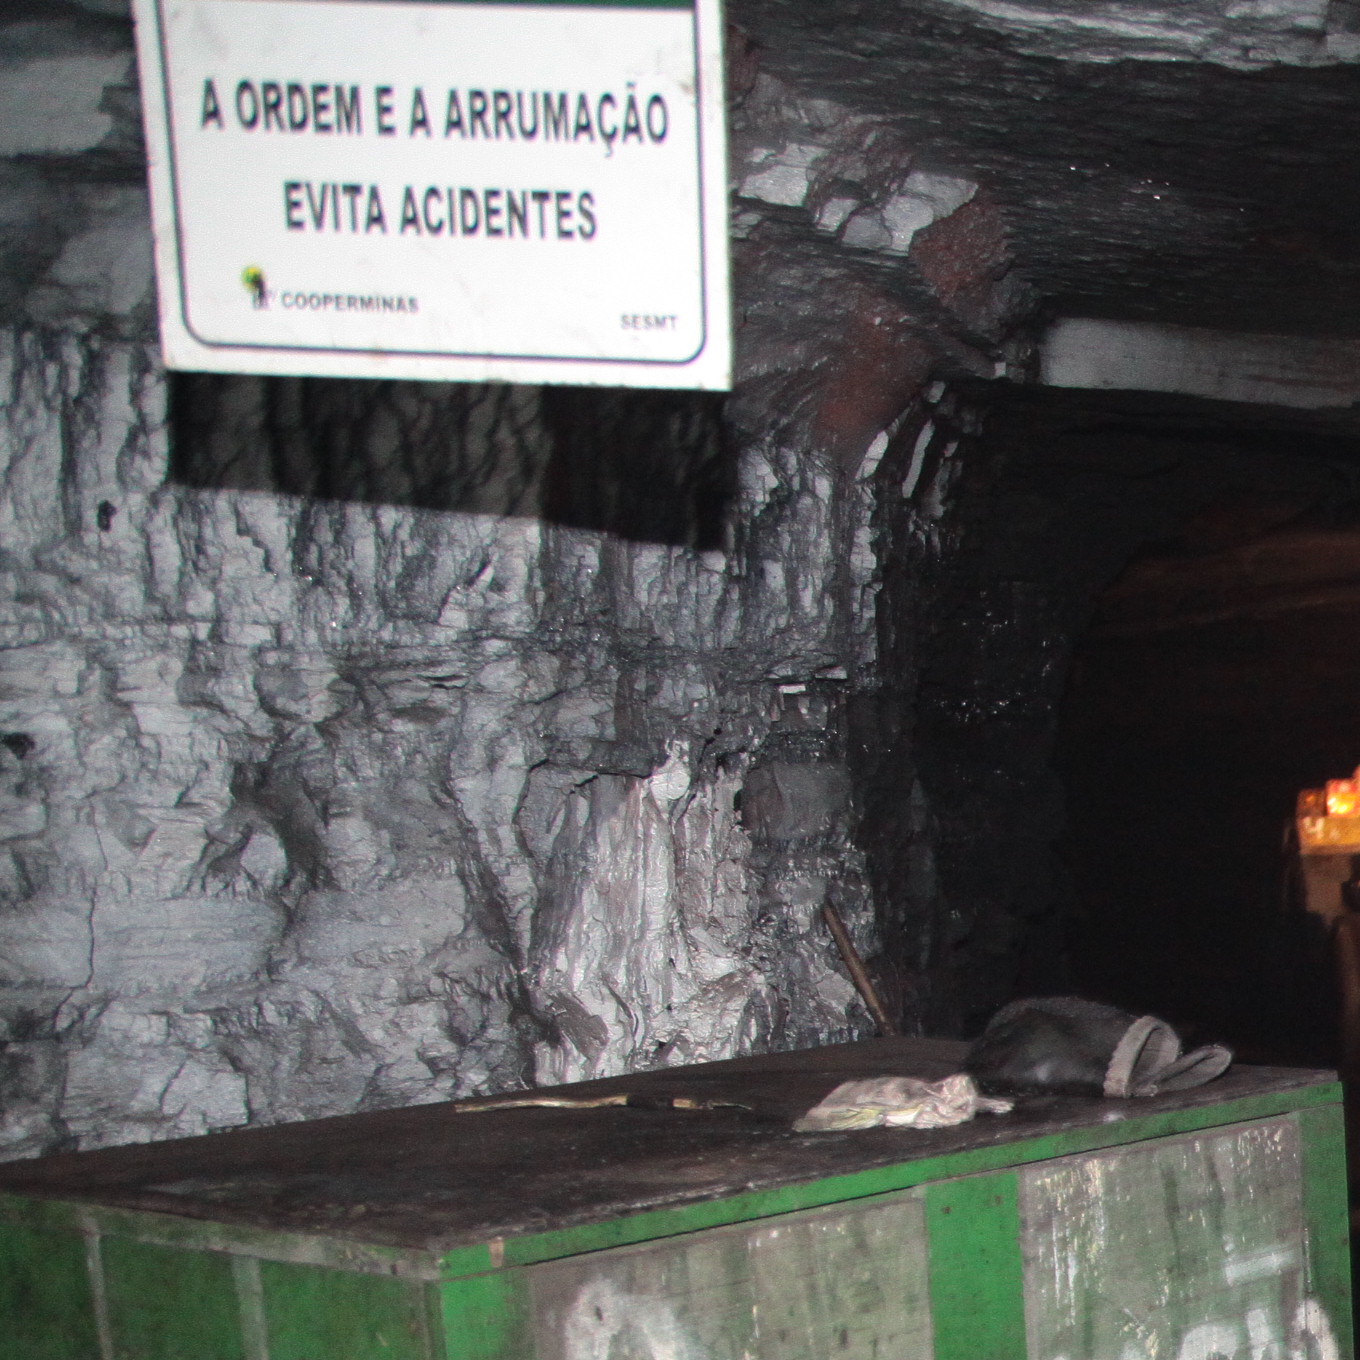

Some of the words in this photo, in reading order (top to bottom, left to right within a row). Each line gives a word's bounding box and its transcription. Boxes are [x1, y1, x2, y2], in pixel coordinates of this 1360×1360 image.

[201, 78, 225, 129] A
[235, 80, 362, 134] ORDEM
[375, 86, 397, 135] E
[409, 87, 432, 138] A
[444, 80, 667, 157] ARRUMAÇÃO
[283, 181, 388, 234] EVITA
[400, 185, 597, 239] ACIDENTES
[281, 291, 419, 313] COOPERMINAS
[620, 314, 678, 330] SESMT
